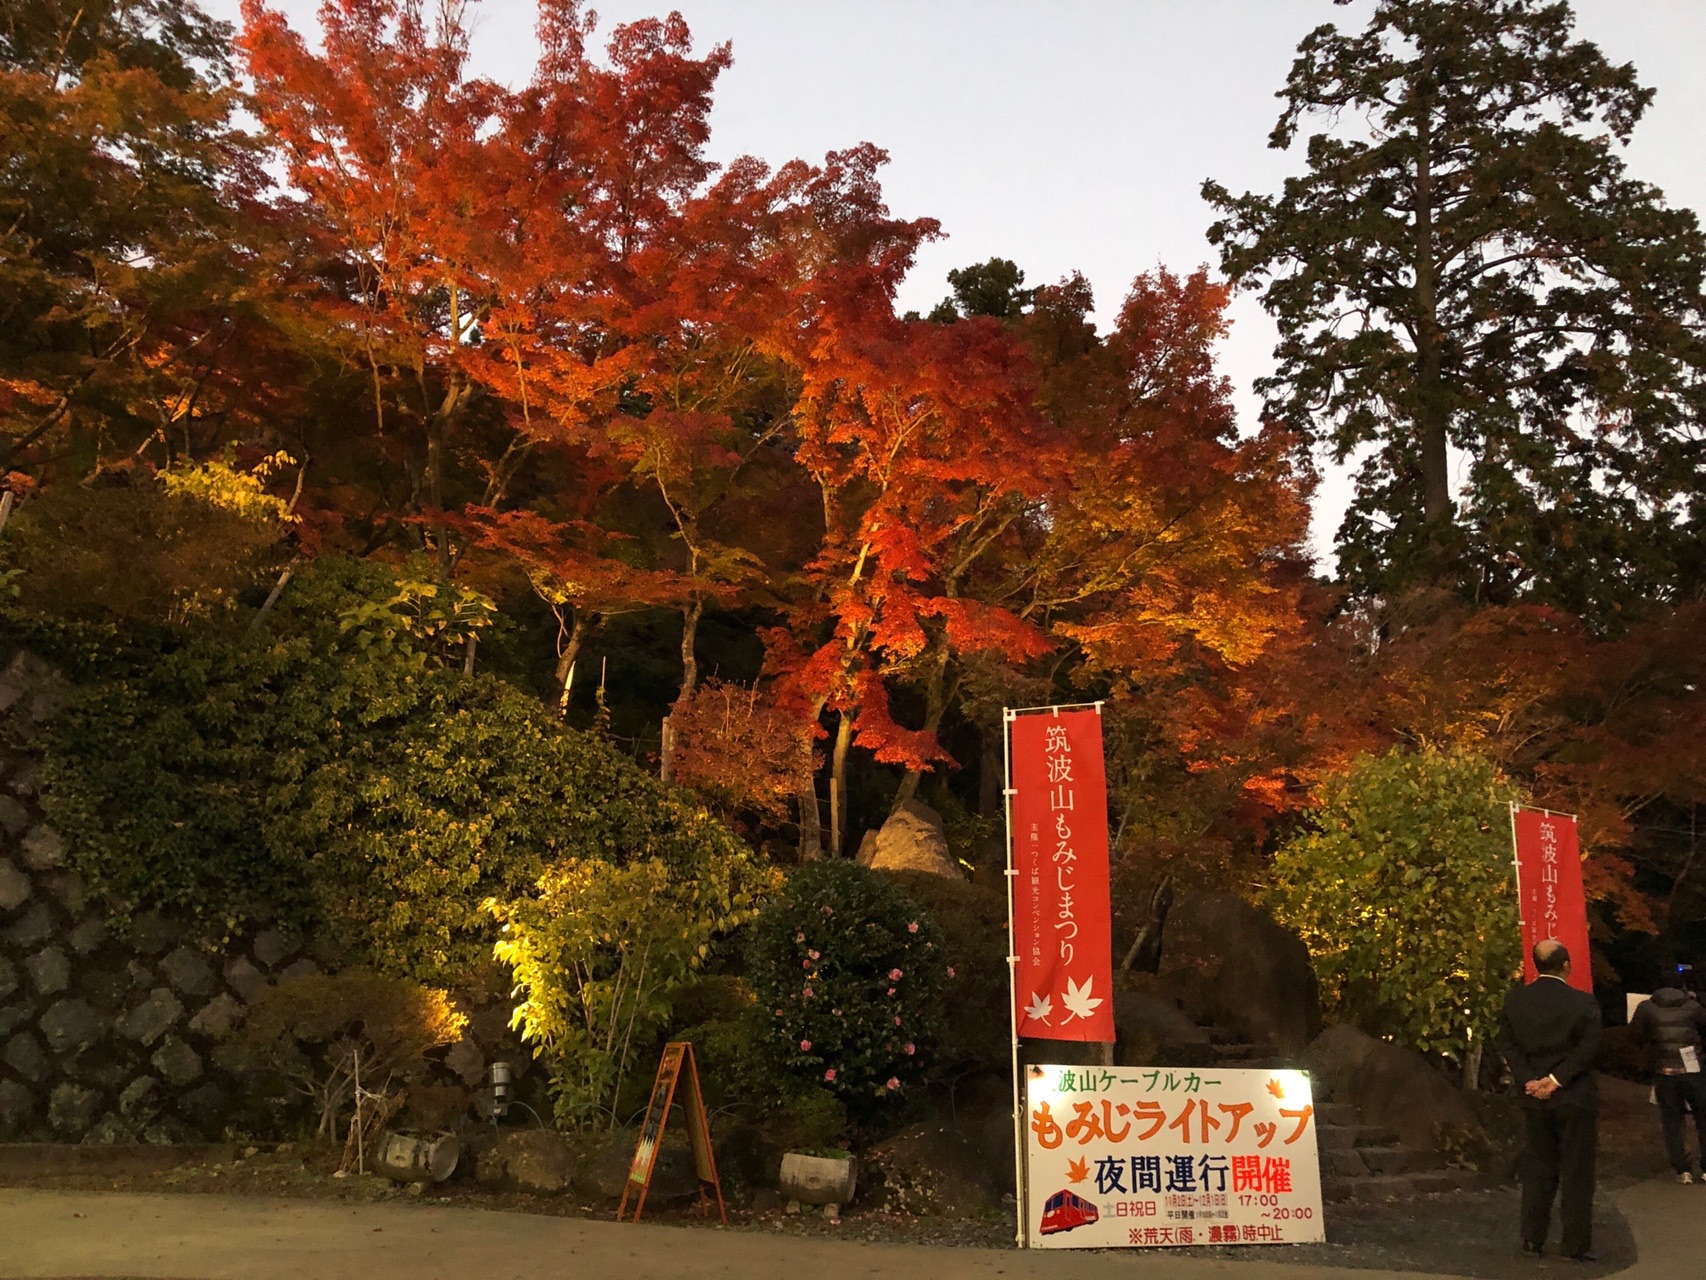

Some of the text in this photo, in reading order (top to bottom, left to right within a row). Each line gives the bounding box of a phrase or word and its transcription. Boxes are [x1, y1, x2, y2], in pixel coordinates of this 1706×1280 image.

[1045, 725, 1078, 966] 筑波山もみじまつり
[1054, 1070, 1222, 1093] 波山ケーブルカー
[1031, 1098, 1313, 1149] もみじライトアップ
[1238, 1194, 1278, 1207] 17:00
